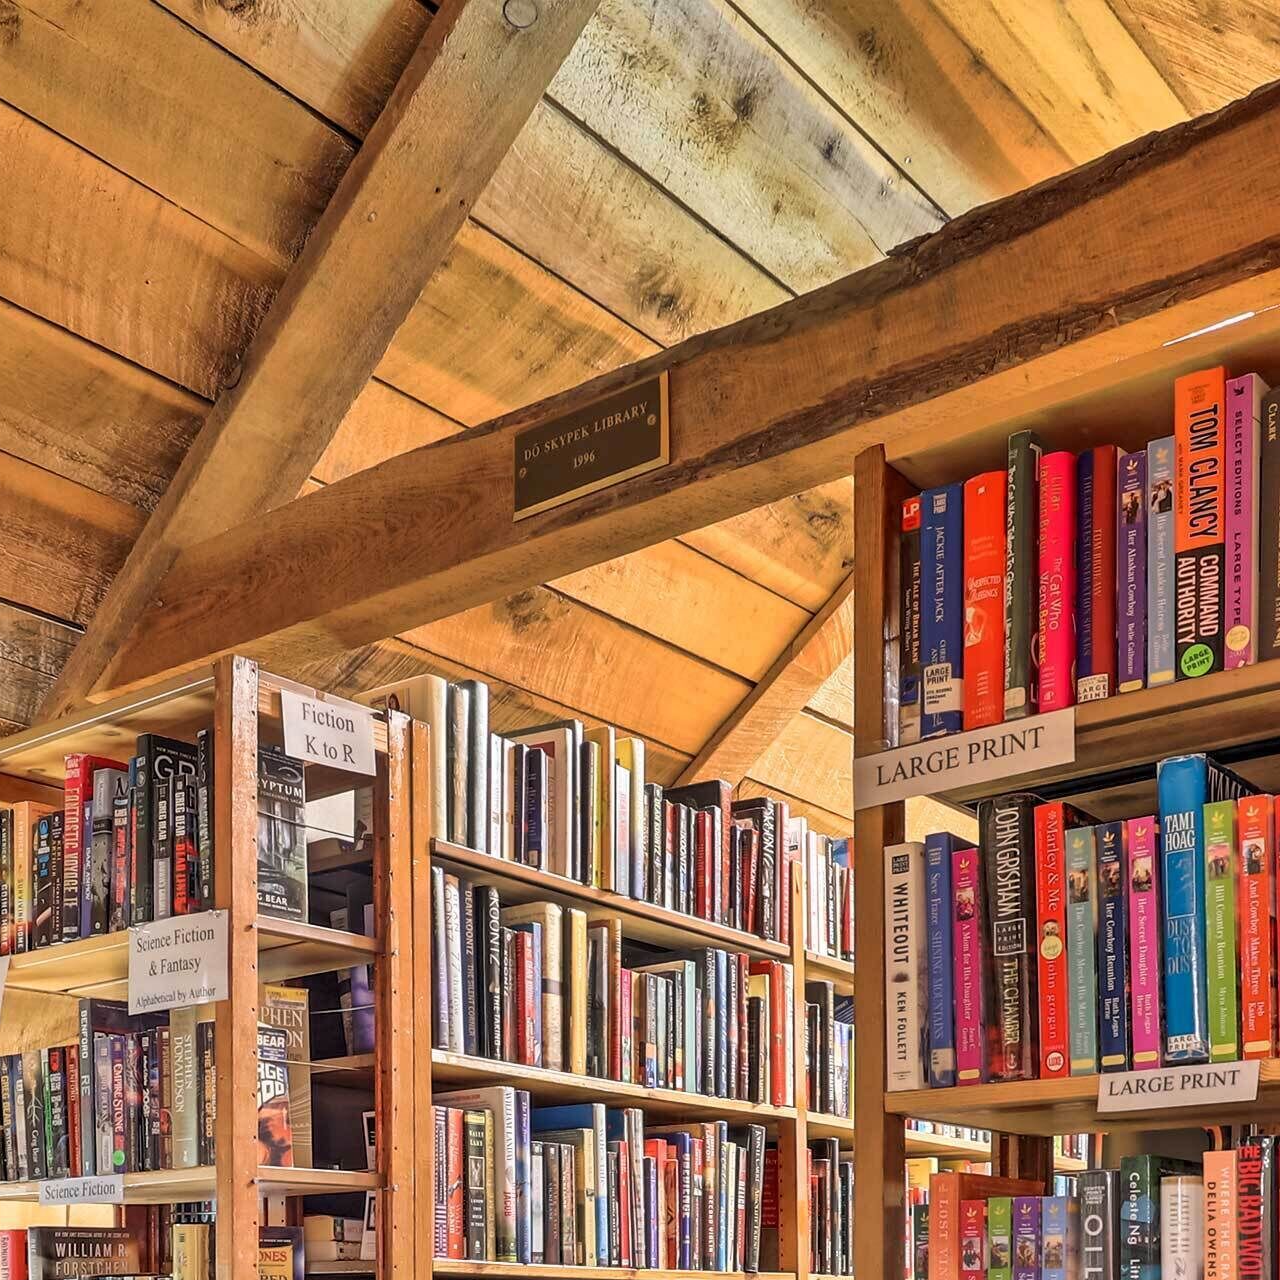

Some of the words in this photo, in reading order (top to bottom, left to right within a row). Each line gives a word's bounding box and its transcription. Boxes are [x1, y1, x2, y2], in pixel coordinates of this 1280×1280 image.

[544, 425, 590, 453] SKYPEK
[593, 401, 648, 433] LIBRARY
[1189, 404, 1218, 453] TOM
[573, 449, 596, 469] 1996
[1189, 457, 1219, 539] CLANCY
[1177, 556, 1196, 644] AUTHORITY
[1199, 554, 1219, 638] COMMAND
[302, 703, 355, 733] Fiction
[306, 735, 321, 753] K
[323, 739, 338, 758] to
[342, 744, 356, 763] R
[876, 742, 959, 787] LARGE
[965, 725, 1045, 770] PRINT
[995, 807, 1019, 849] JOHN
[1164, 811, 1195, 831] TAMI
[1165, 830, 1196, 851] HOAG
[995, 850, 1020, 917] GRISHAM
[136, 932, 171, 953] Science
[173, 927, 215, 946] Fiction
[489, 893, 500, 965] KOONTZ
[893, 882, 909, 963] WHITEOUT
[148, 962, 157, 976] &
[160, 955, 201, 977] Fantasy
[1004, 958, 1018, 985] THE
[177, 989, 186, 1003] by
[189, 986, 216, 1000] Author
[896, 992, 906, 1010] KEN
[1004, 985, 1020, 1046] CHAMBER
[897, 1017, 907, 1060] FOLLETT
[1108, 1076, 1170, 1098] LARGE
[1176, 1070, 1241, 1093] PRINT
[45, 1183, 79, 1200] Science
[82, 1180, 116, 1197] Fiction
[1129, 1172, 1140, 1220] Celeste
[1207, 1182, 1216, 1224] DELIA
[55, 1243, 117, 1257] WILLIAM
[1127, 1223, 1140, 1245] Ng
[55, 1261, 128, 1276] FORSTCHEN
[1207, 1228, 1217, 1278] OWENS
